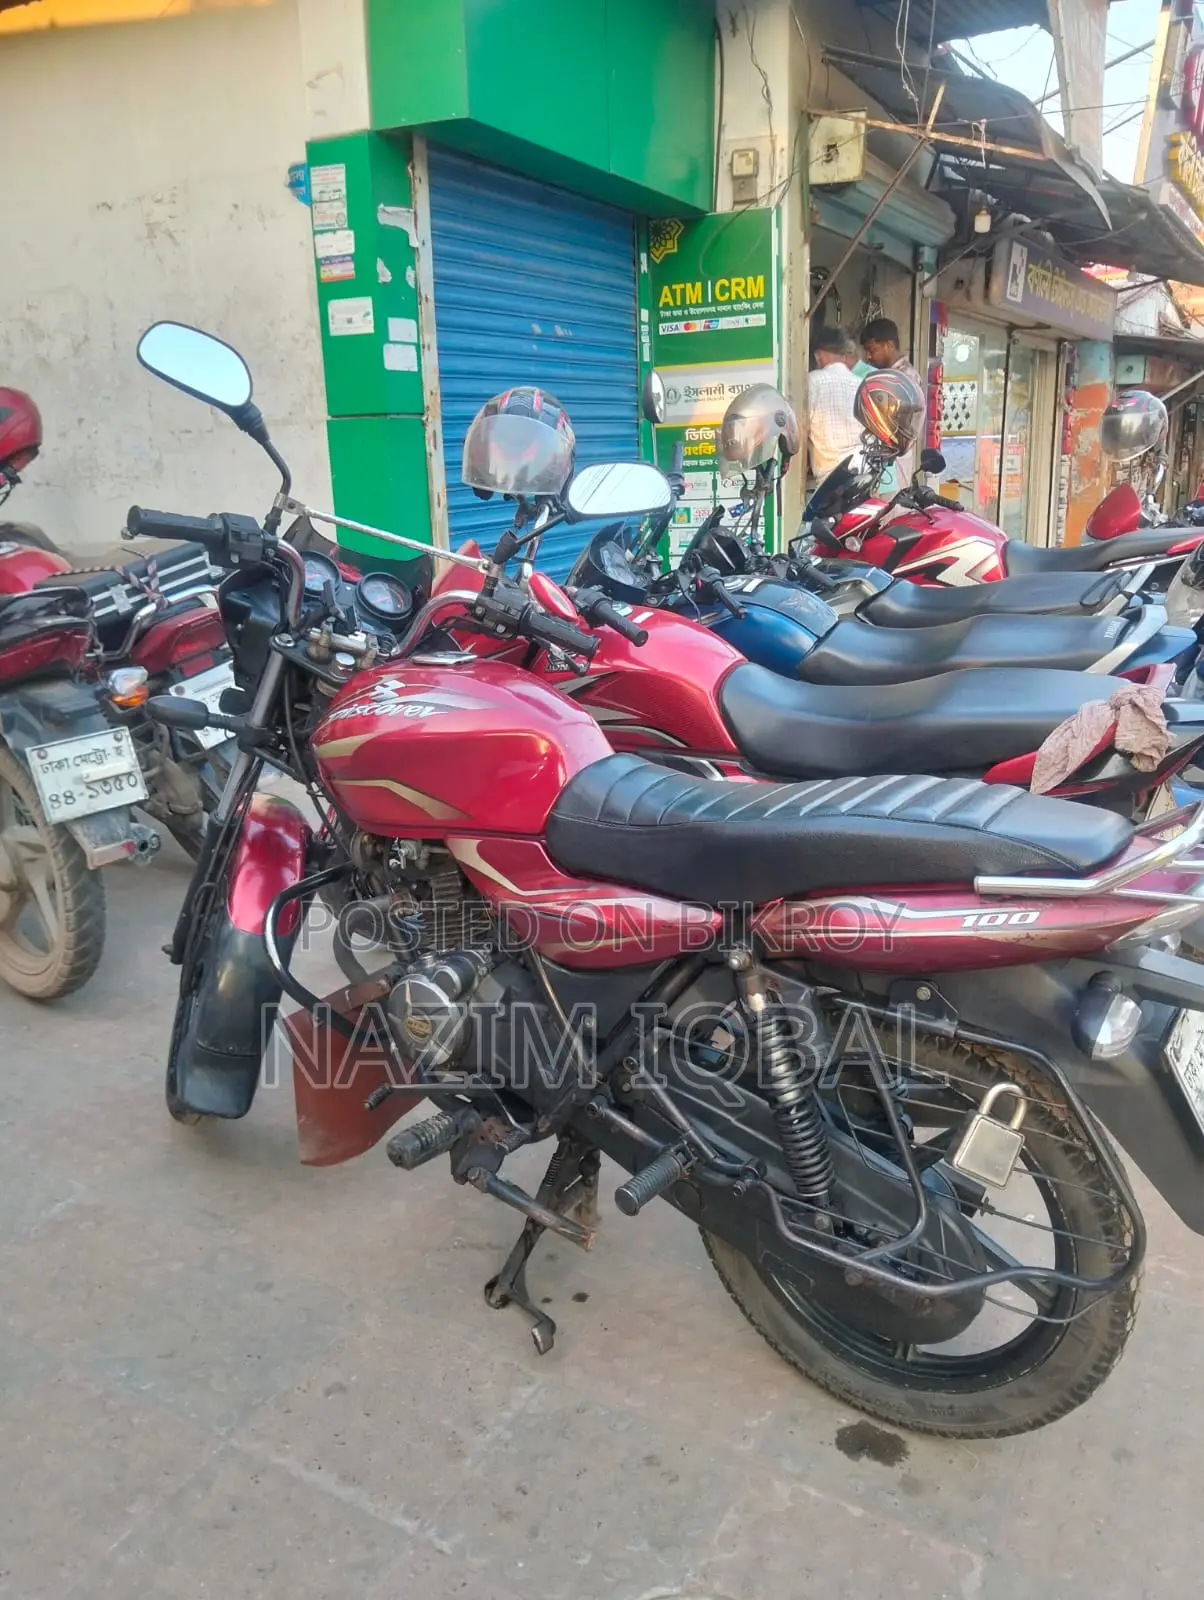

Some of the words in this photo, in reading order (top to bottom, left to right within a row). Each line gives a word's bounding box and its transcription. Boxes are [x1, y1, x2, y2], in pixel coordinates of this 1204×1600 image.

[659, 283, 702, 307] ATM
[715, 276, 764, 302] CRM
[660, 323, 680, 333] VISA
[684, 384, 724, 397] ইসলামী
[40, 760, 70, 774] ঢাকা
[962, 911, 1040, 928] 100
